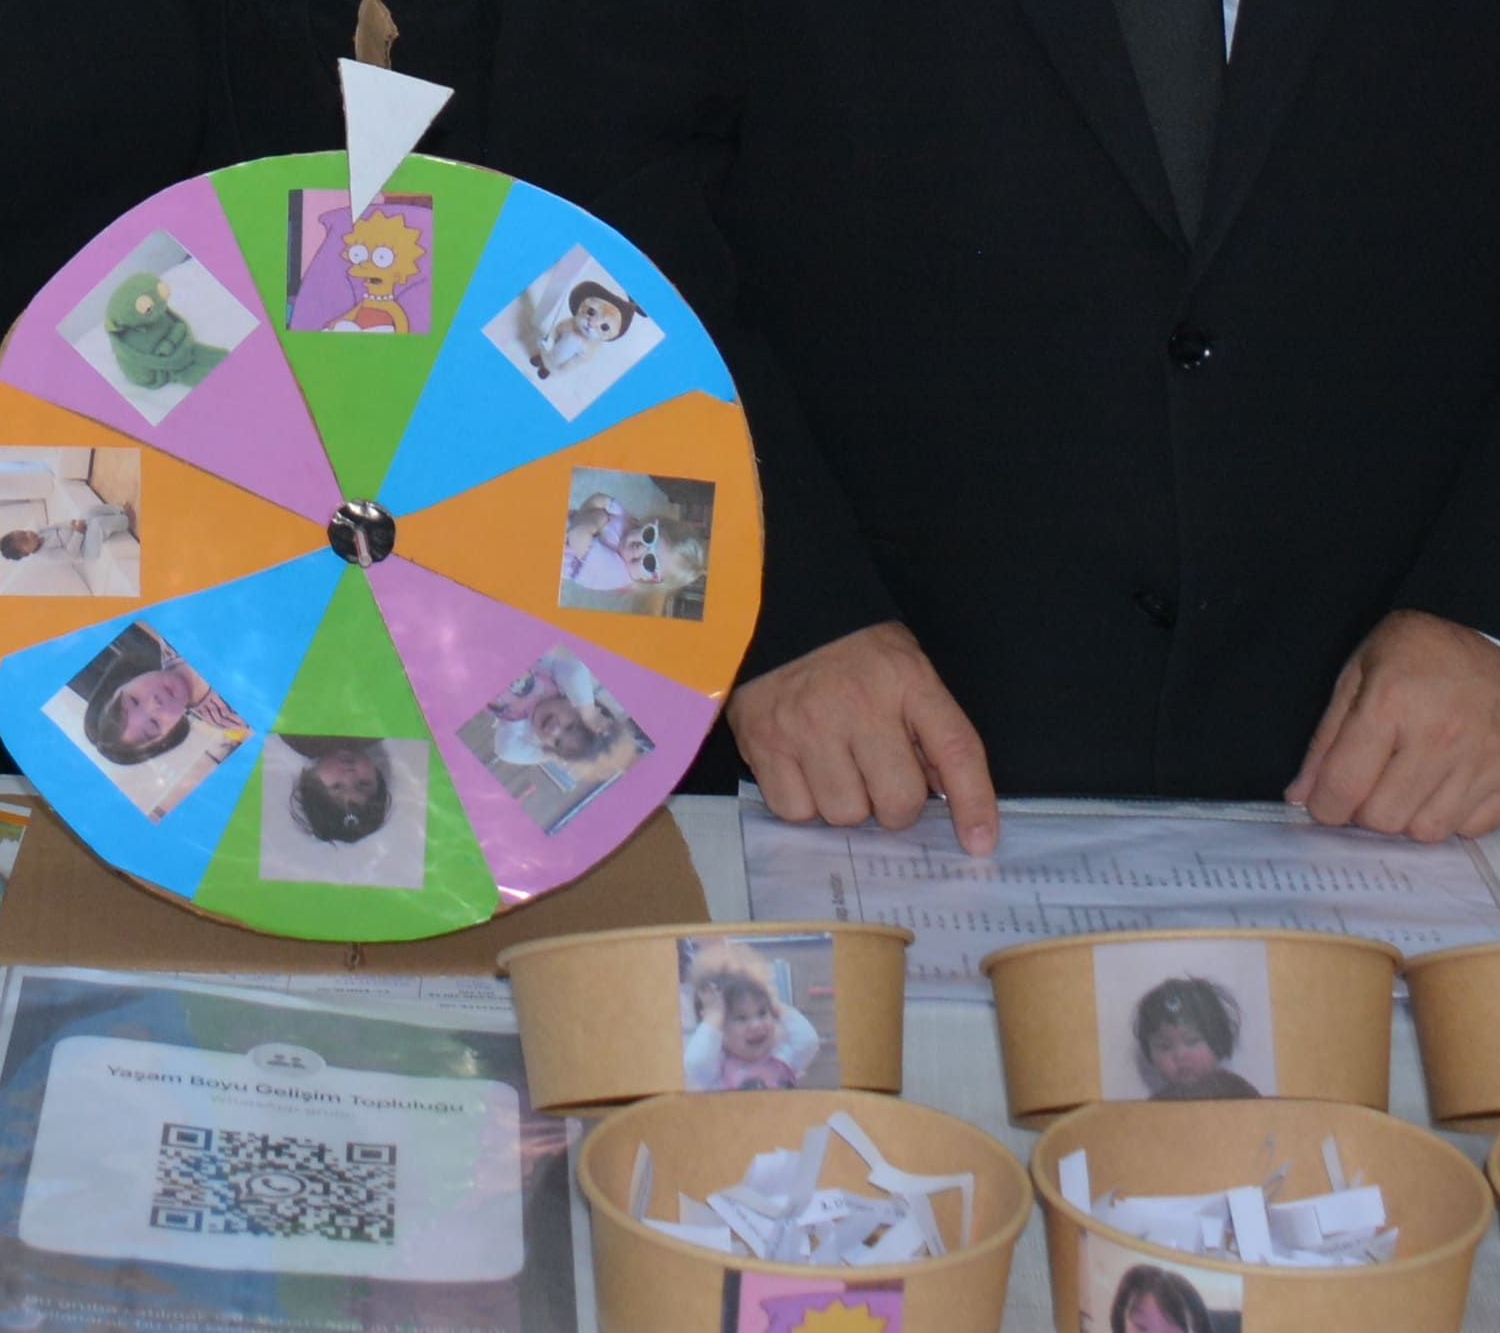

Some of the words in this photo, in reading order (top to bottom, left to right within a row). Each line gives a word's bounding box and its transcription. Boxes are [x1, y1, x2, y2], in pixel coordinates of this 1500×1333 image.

[107, 1064, 182, 1084] Yaşam
[190, 1075, 249, 1094] Boyu
[255, 1083, 342, 1104] Gelişim
